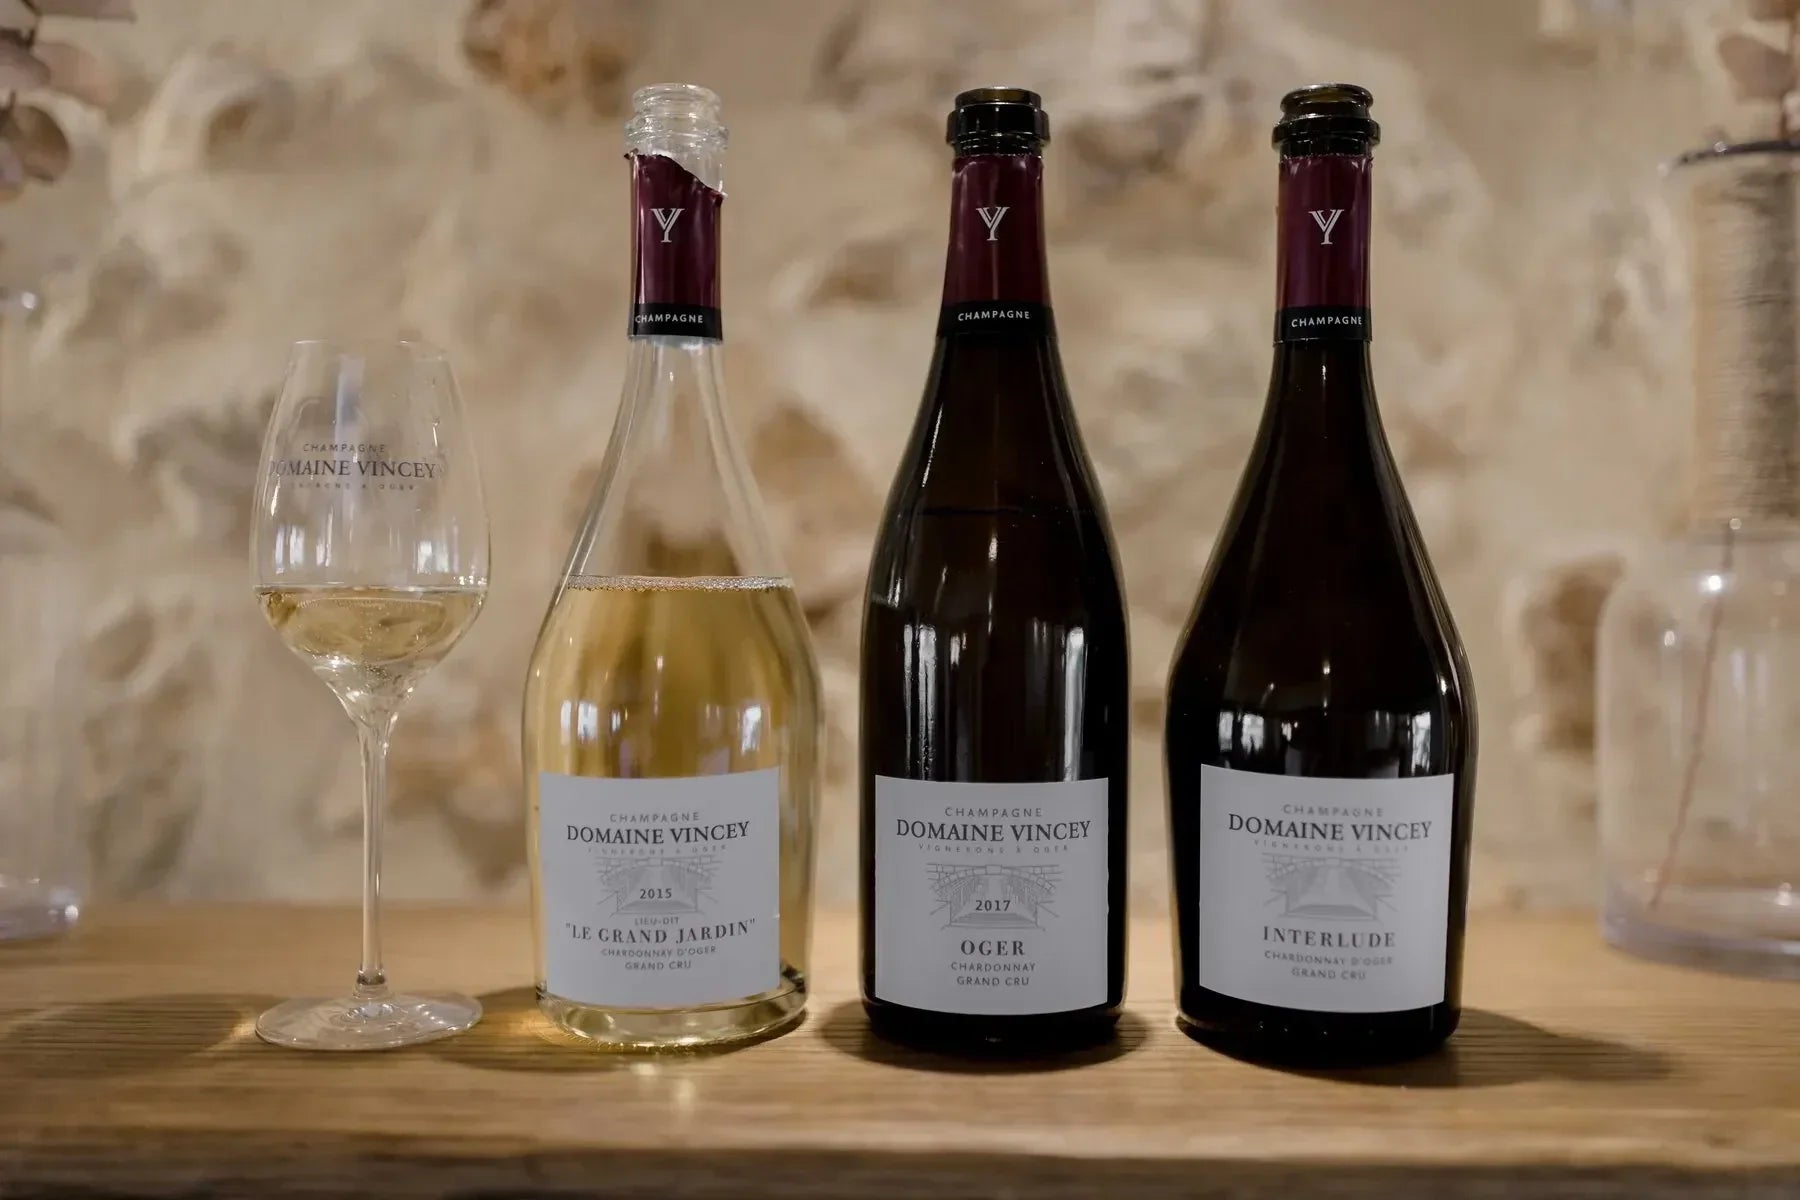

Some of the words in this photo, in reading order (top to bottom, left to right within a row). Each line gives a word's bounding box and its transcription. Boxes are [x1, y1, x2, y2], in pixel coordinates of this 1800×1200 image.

[635, 313, 704, 324] CHAMPAGNE
[958, 310, 1030, 321] CHAMPAGNE
[1291, 316, 1362, 327] CHAMPAGNE
[303, 443, 386, 453] CHAMPAGNE
[356, 460, 437, 478] VINCEY
[944, 806, 1043, 818] CHAMPAGNE
[1282, 803, 1384, 817] CHAMPAGNE
[609, 811, 700, 823] CHAMPAGNE
[567, 824, 664, 845] DOMAINE
[670, 820, 750, 843] VINCEY
[896, 818, 1005, 842] DOMAINE
[1010, 820, 1091, 842] VINCEY
[1228, 813, 1344, 841] DOMAINE
[1350, 820, 1432, 842] VINCEY
[639, 888, 673, 900] 2015
[975, 900, 1011, 911] 2017
[634, 916, 680, 926] LIEU-DIT
[565, 922, 592, 940] "LE
[598, 928, 668, 944] GRAND
[675, 917, 756, 944] JARDIN"
[1263, 926, 1396, 948] INTERLUDE
[601, 947, 673, 958] CHARDONNAY
[677, 945, 717, 956] D'OGER
[960, 939, 1025, 956] OGER
[1264, 950, 1345, 966] CHARDONNAY
[1351, 956, 1393, 966] D'OGER
[624, 961, 664, 970] GRAND
[668, 960, 692, 969] CRU
[950, 961, 1036, 972] CHARDONNAY
[1291, 967, 1336, 980] GRAND
[1340, 969, 1366, 980] CRU
[956, 975, 1000, 986] GRAND
[1005, 976, 1030, 986] CRU
